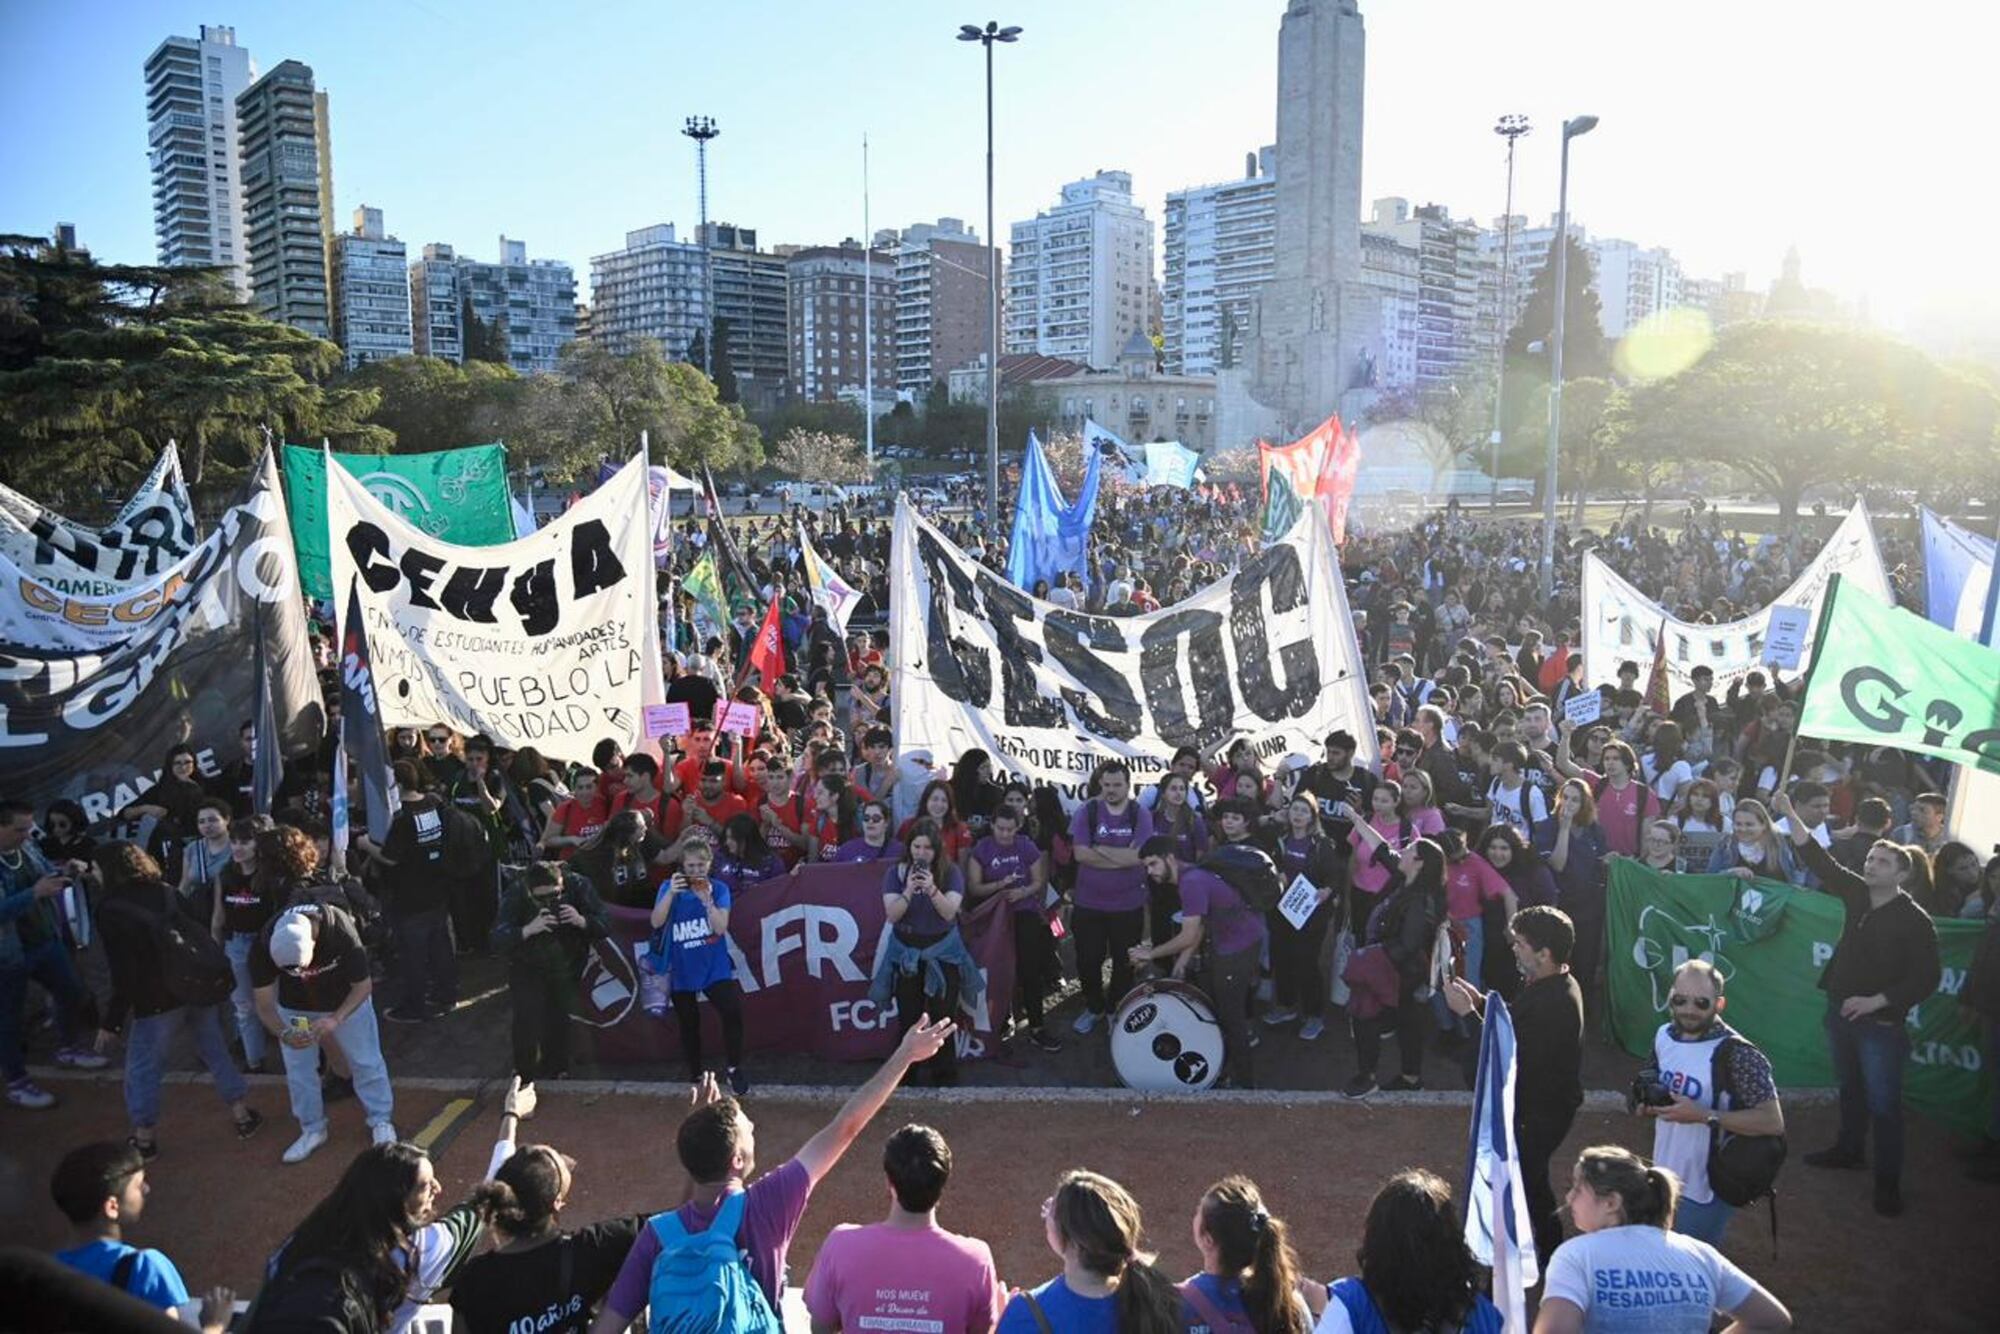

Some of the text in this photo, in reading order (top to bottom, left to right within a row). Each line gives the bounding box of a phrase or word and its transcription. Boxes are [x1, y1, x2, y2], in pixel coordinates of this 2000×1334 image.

[434, 630, 525, 656] ESTUDIANTES
[604, 648, 641, 688] LA
[1044, 749, 1063, 769] DE
[672, 917, 714, 943] AMSA
[1595, 1269, 1708, 1291] SEAMOS LA
[875, 1289, 930, 1302] NOS MUEVE
[1596, 1290, 1709, 1308] PESADILLA DE
